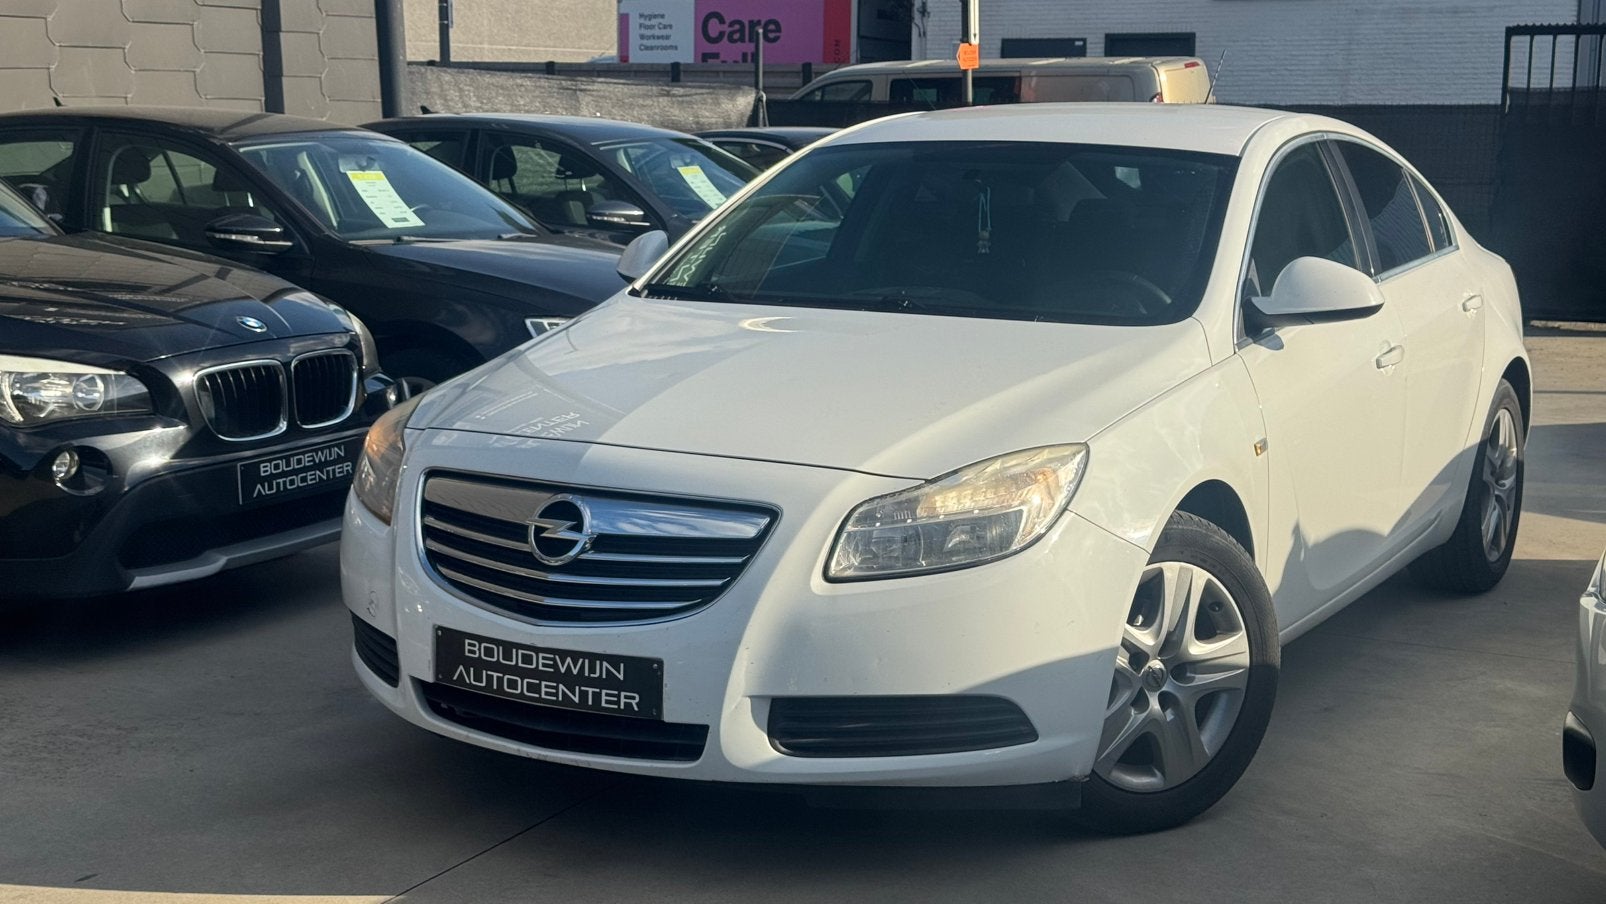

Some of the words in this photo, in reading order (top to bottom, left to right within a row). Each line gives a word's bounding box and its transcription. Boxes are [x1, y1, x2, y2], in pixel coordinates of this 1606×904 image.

[639, 12, 665, 21] Hygiene
[657, 22, 673, 30] Care
[702, 11, 782, 44] Care
[260, 445, 345, 476] BOUDEWIJN
[253, 462, 352, 497] AUTOCENTER
[464, 639, 624, 681] BOUDEWIJN
[453, 664, 640, 711] AUTOCENTER
